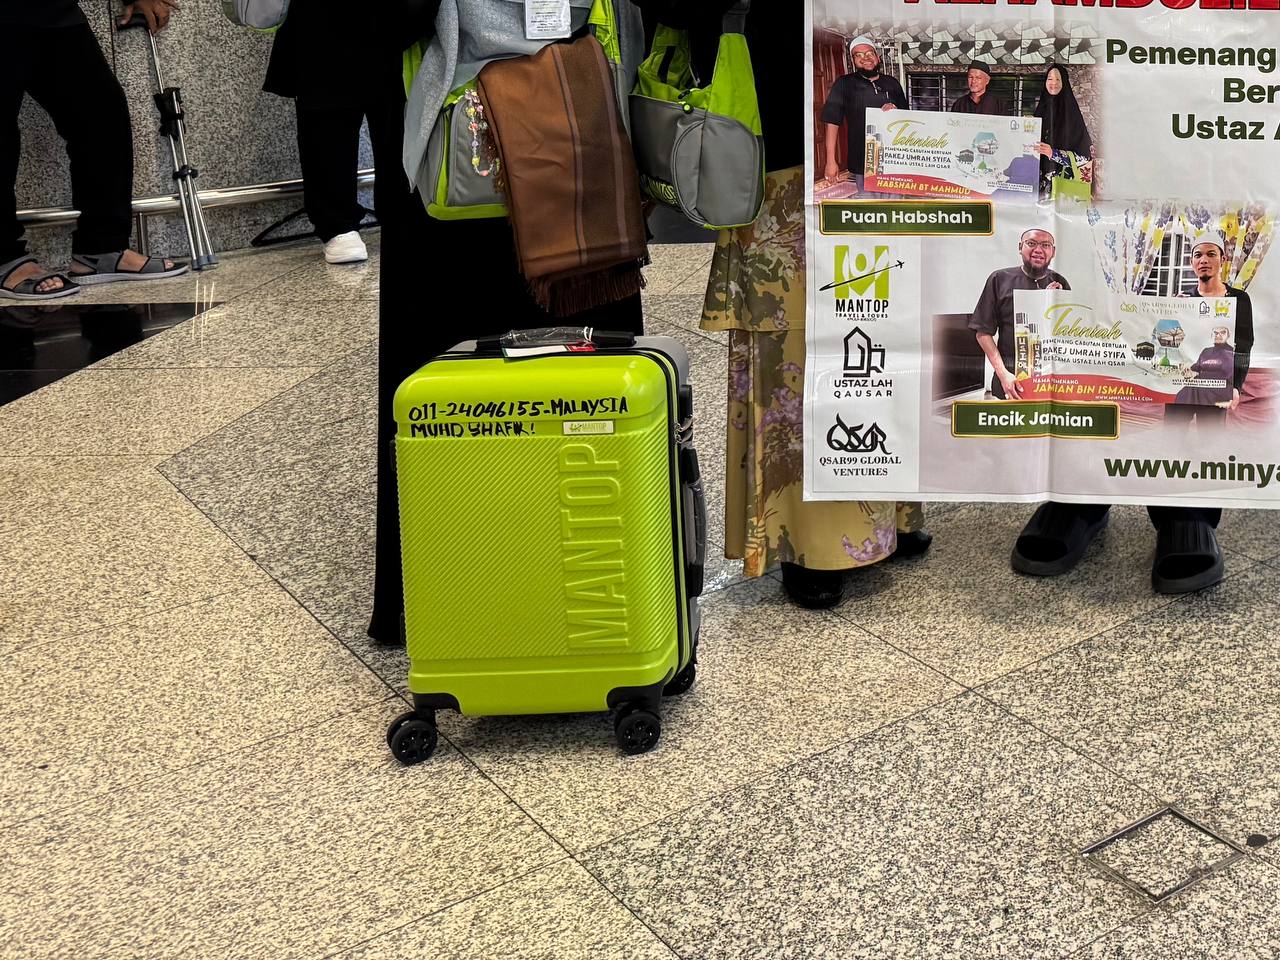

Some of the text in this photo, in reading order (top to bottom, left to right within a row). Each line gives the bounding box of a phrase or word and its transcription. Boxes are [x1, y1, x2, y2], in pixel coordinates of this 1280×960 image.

[1106, 38, 1277, 71] Pemenang
[1172, 113, 1266, 141] Ustaz
[885, 152, 951, 163] PAKEJ UMRAH SYIFA
[877, 180, 971, 195] HABSHAH BT MAHMUD
[841, 209, 973, 225] Puan Habshah
[835, 299, 889, 313] MANTOP
[1043, 346, 1127, 359] PAKEJ UMRAH SYIFA
[834, 379, 893, 388] USTAZ LAH
[1033, 383, 1135, 396] JAMIAN BIN ISMAIL
[834, 389, 893, 398] QAUSAR
[977, 411, 1094, 428] Encik Jamian
[411, 422, 464, 437] MUHD
[819, 456, 902, 466] QSAR99 GLOBAL
[833, 467, 888, 477] VENTURES
[559, 443, 629, 650] MANTOP
